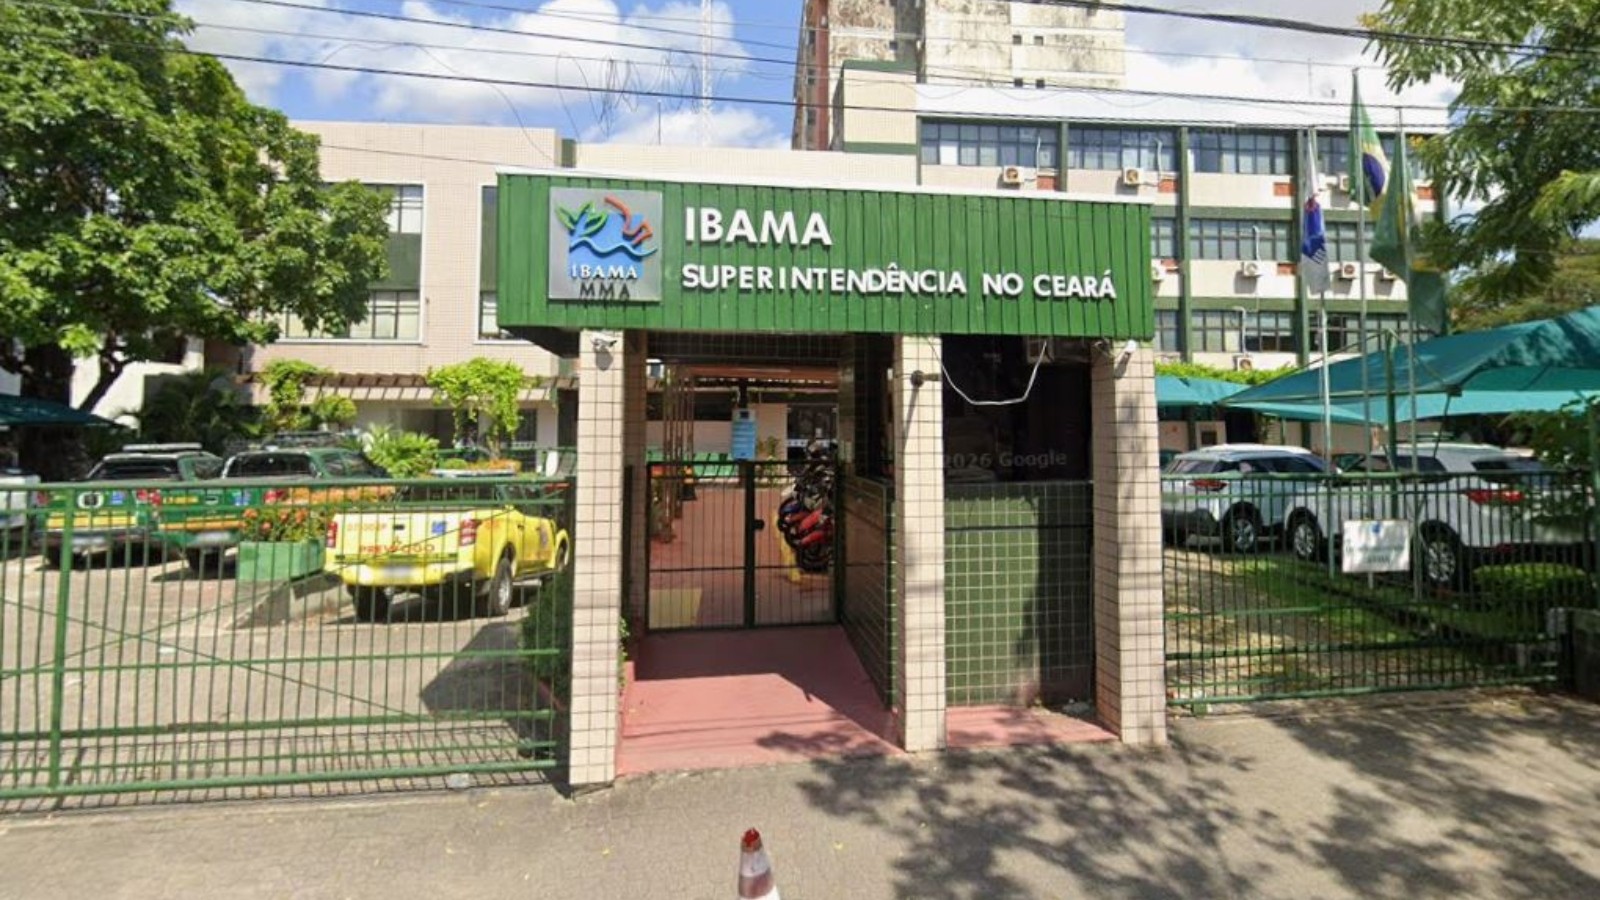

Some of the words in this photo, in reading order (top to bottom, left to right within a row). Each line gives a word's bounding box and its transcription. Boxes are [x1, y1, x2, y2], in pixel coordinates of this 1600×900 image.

[685, 206, 833, 246] IBAMA
[570, 263, 638, 280] IBAMA
[682, 262, 967, 294] SUPERINTENDÊNCIA
[982, 272, 1024, 297] NO
[1033, 269, 1117, 299] CEARÁ
[579, 281, 630, 299] MMA
